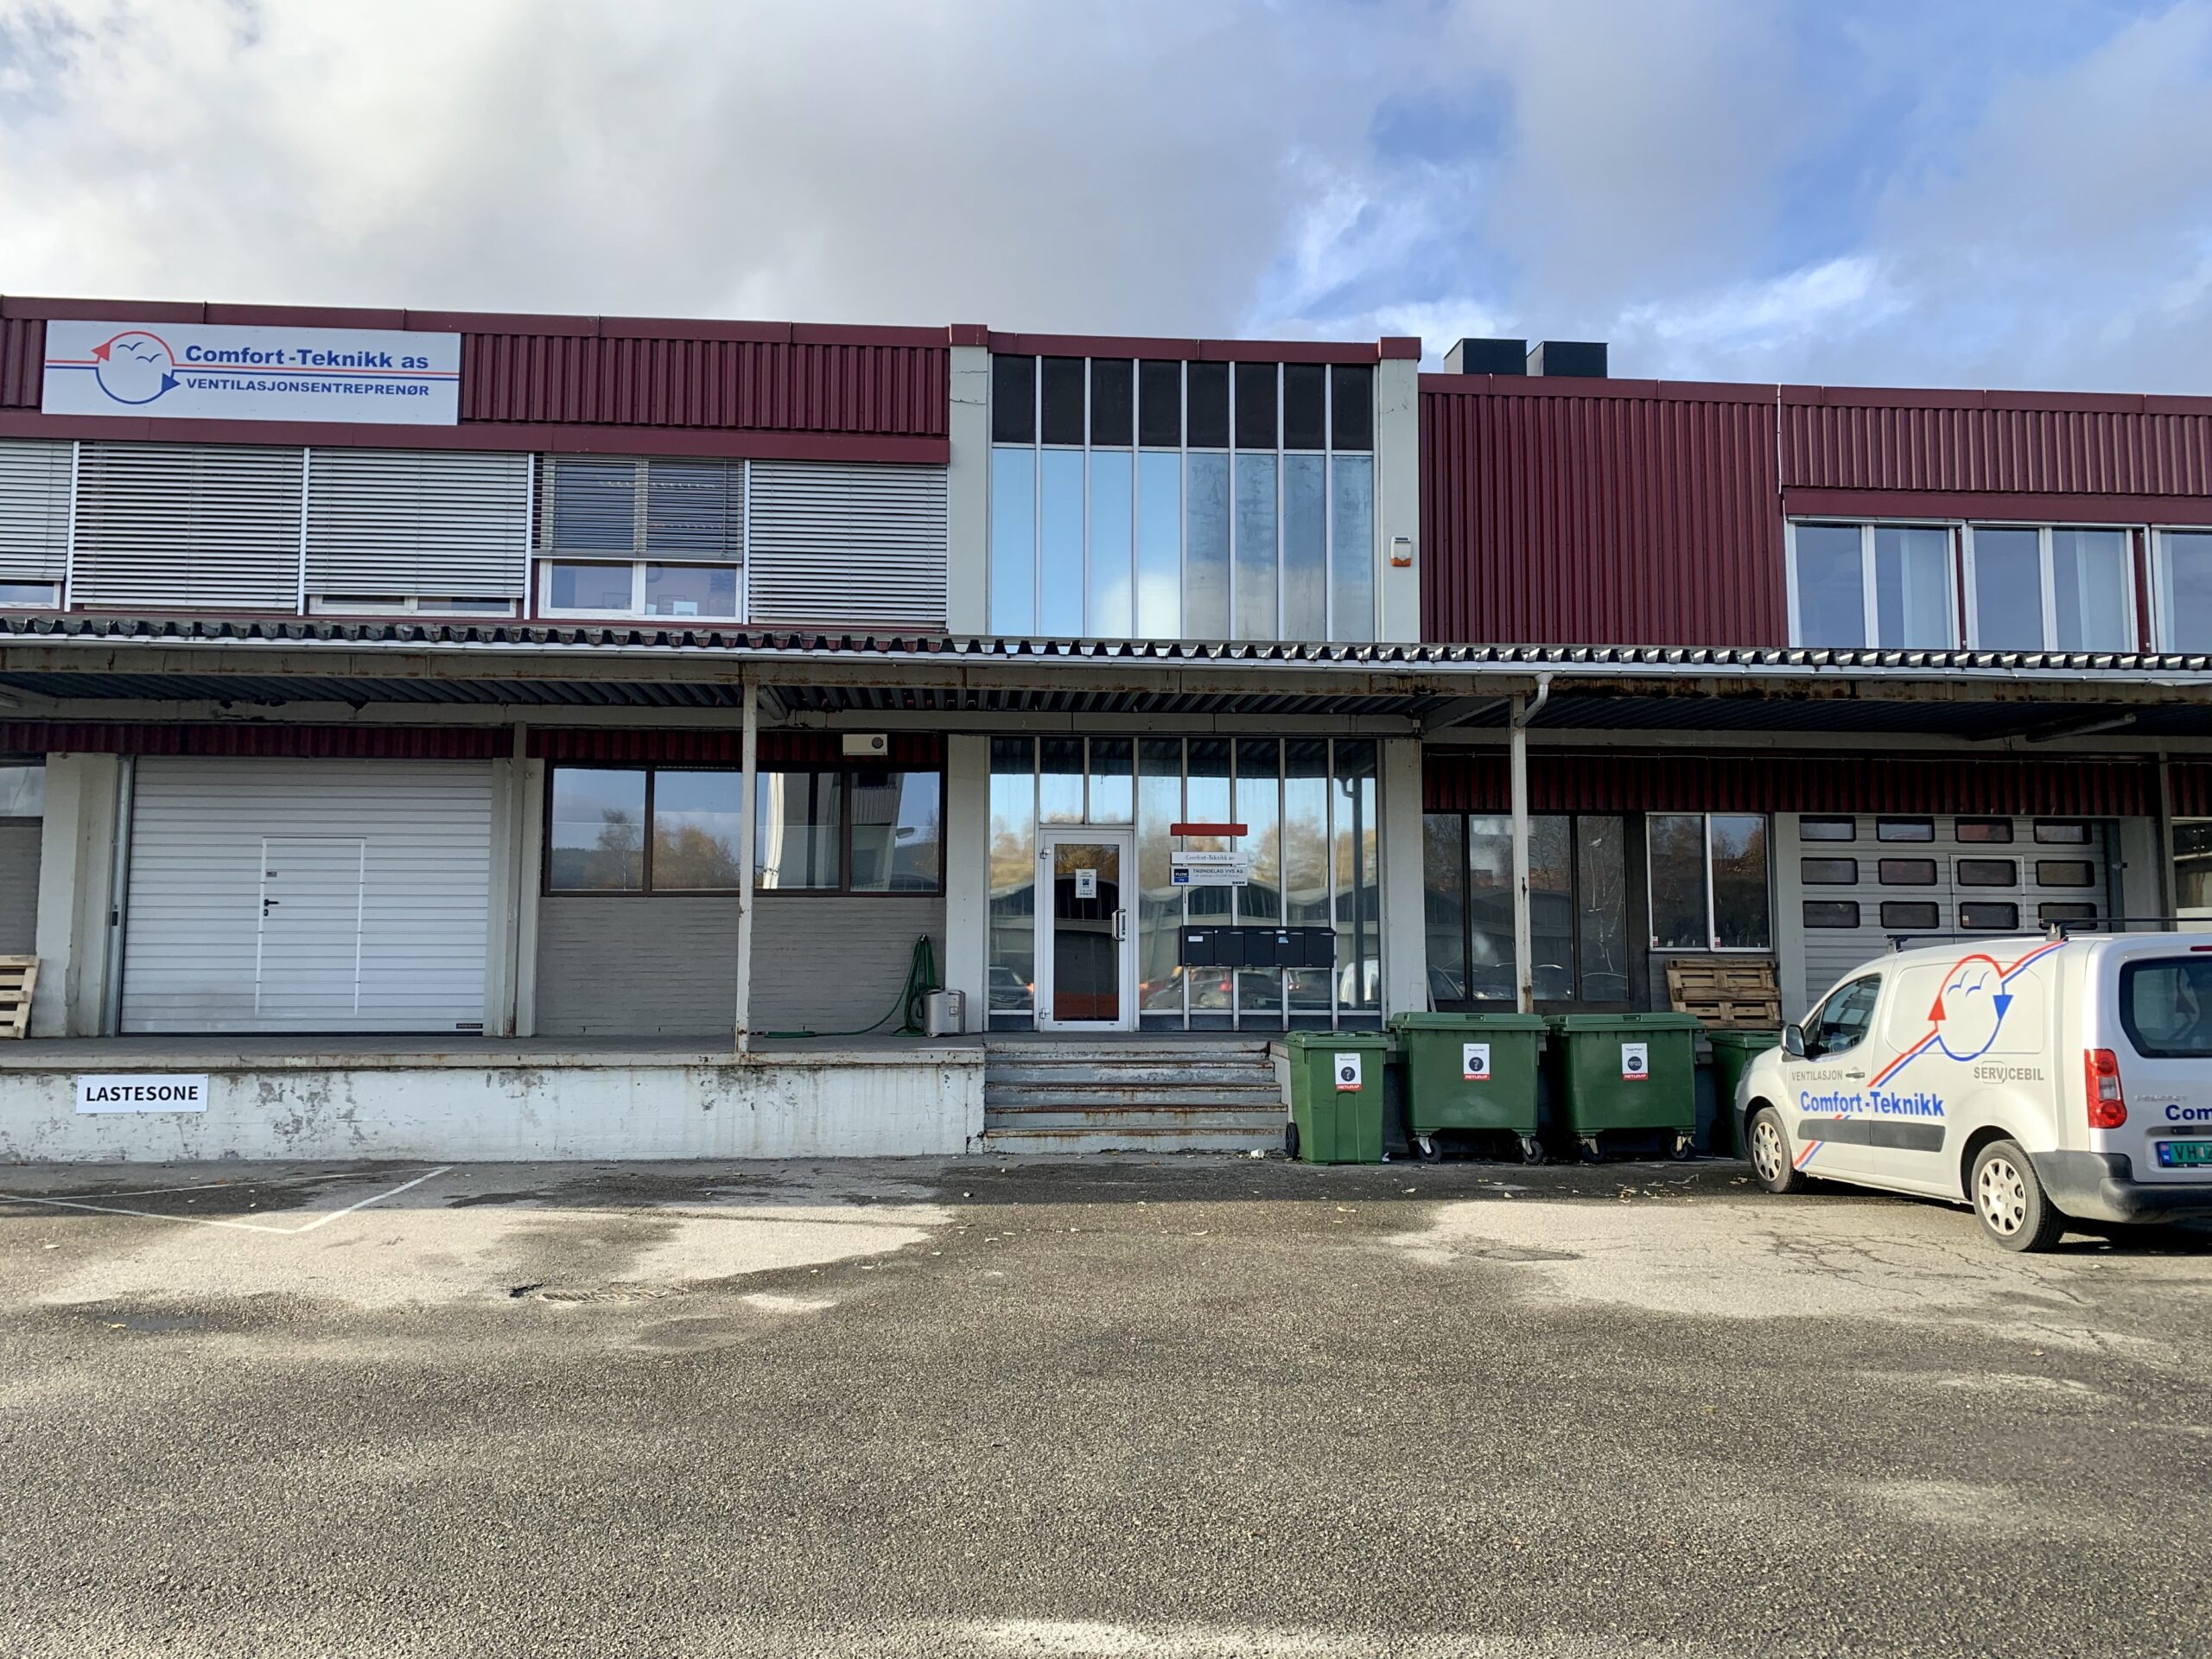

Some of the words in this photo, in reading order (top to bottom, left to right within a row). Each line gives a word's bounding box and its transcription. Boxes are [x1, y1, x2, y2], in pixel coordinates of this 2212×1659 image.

[186, 346, 392, 368] Comfort-Teknikk
[401, 355, 429, 369] as
[187, 378, 429, 396] VENTILASJONSENTREPRENØR
[1791, 1070, 1843, 1081] VENTILASJON
[1974, 1066, 2045, 1081] SERVICEBIL
[86, 1086, 199, 1102] LASTESONE
[1800, 1090, 1945, 1116] Comfort-Teknikk
